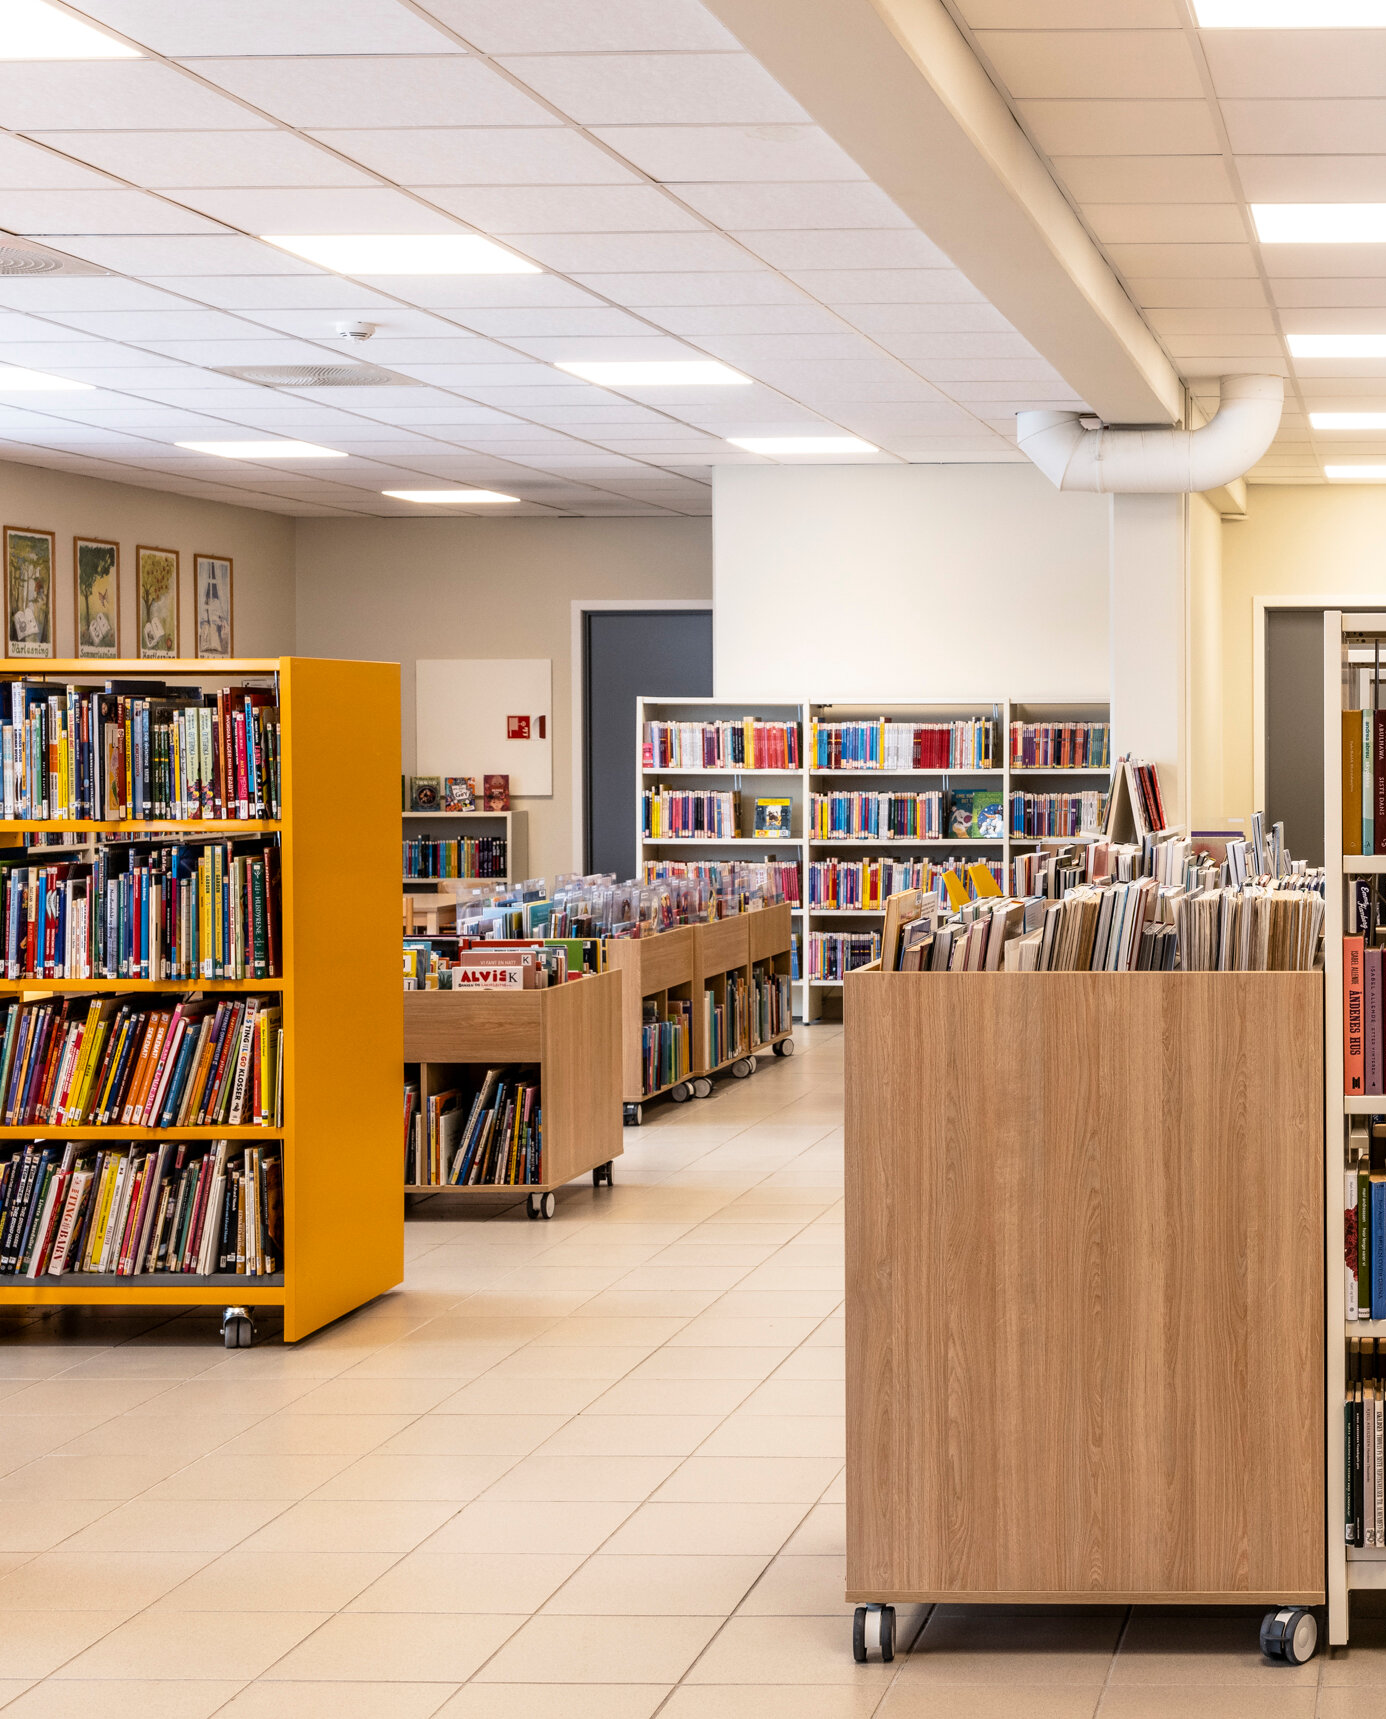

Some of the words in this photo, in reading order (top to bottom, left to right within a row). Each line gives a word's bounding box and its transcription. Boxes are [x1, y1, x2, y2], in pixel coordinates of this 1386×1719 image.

[508, 972, 518, 982] K
[1349, 991, 1362, 1033] ÅNDENES
[243, 1025, 252, 1042] TING
[1350, 1037, 1360, 1055] HUS
[235, 1069, 246, 1100] KLOSSER
[64, 1194, 77, 1221] TING
[53, 1230, 68, 1261] BARN
